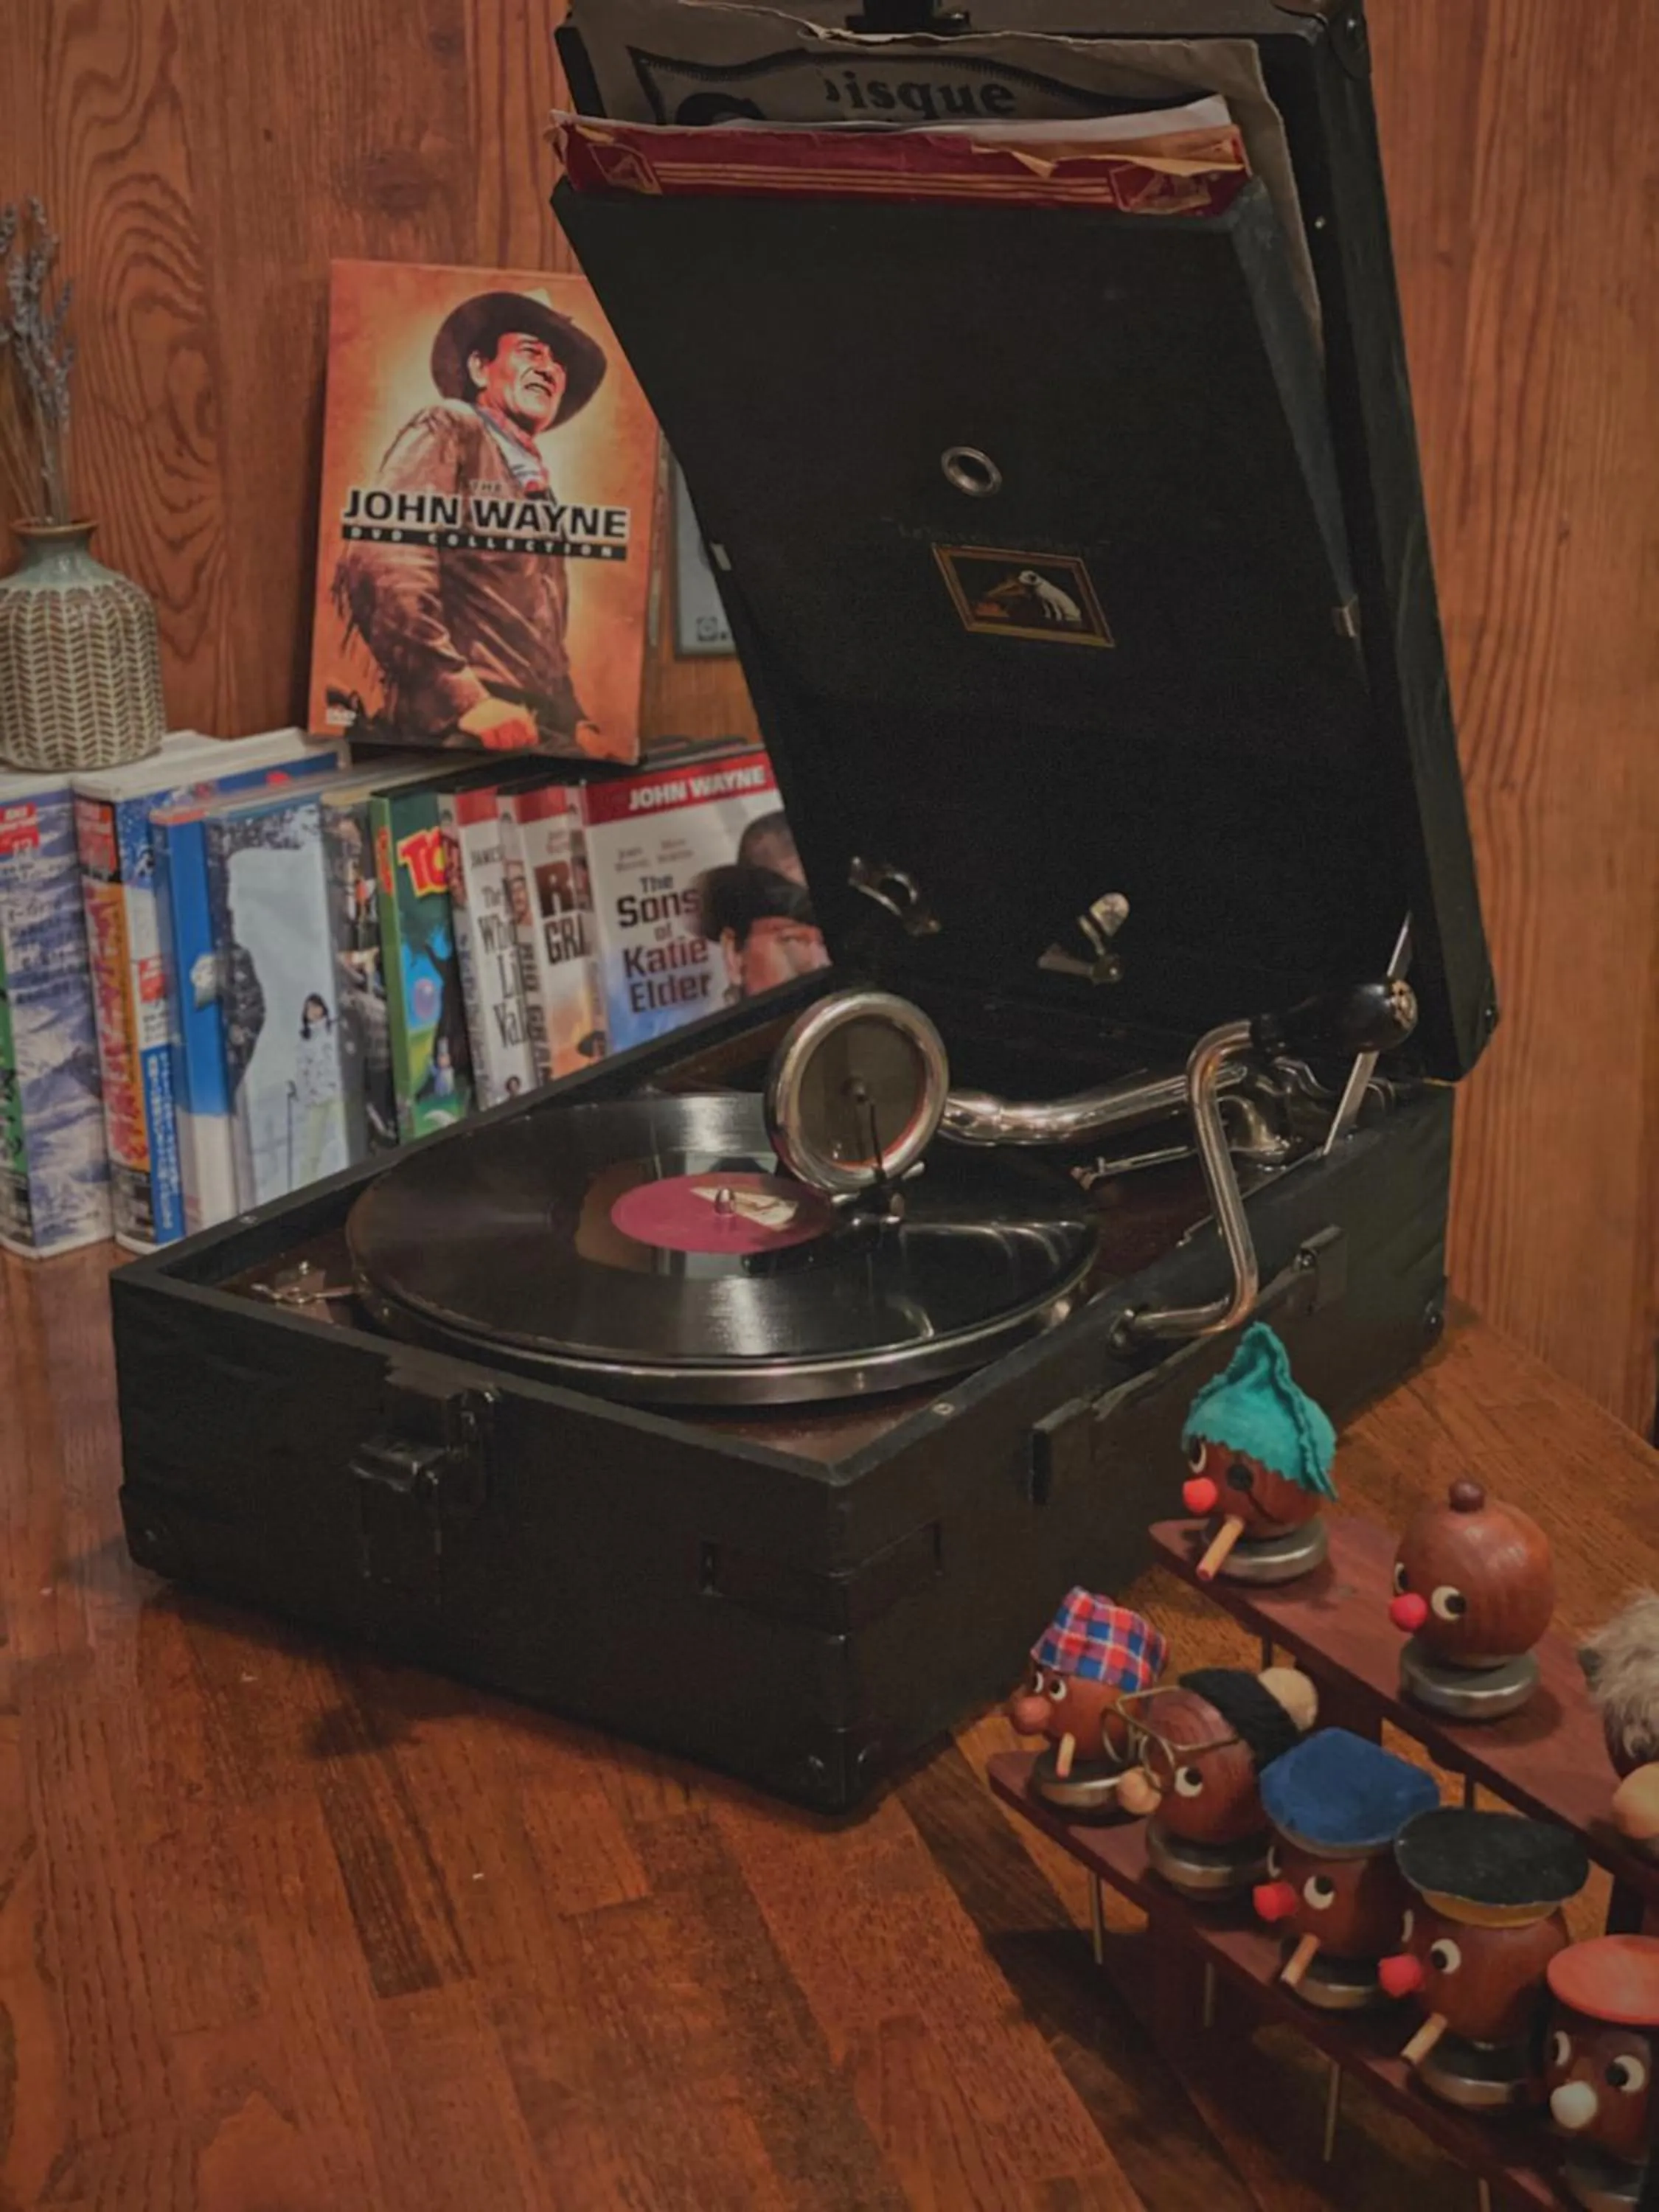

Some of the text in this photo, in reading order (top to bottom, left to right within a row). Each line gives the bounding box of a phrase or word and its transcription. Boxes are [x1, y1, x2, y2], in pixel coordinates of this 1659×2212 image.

[344, 490, 627, 538] JOHN WAYNE
[350, 527, 613, 557] DVD COLLECTION
[628, 765, 766, 810] JOHN WAYNE
[639, 874, 674, 894] The
[617, 888, 701, 928] Sons
[623, 935, 709, 978] Katie
[630, 974, 712, 1013] Elder
